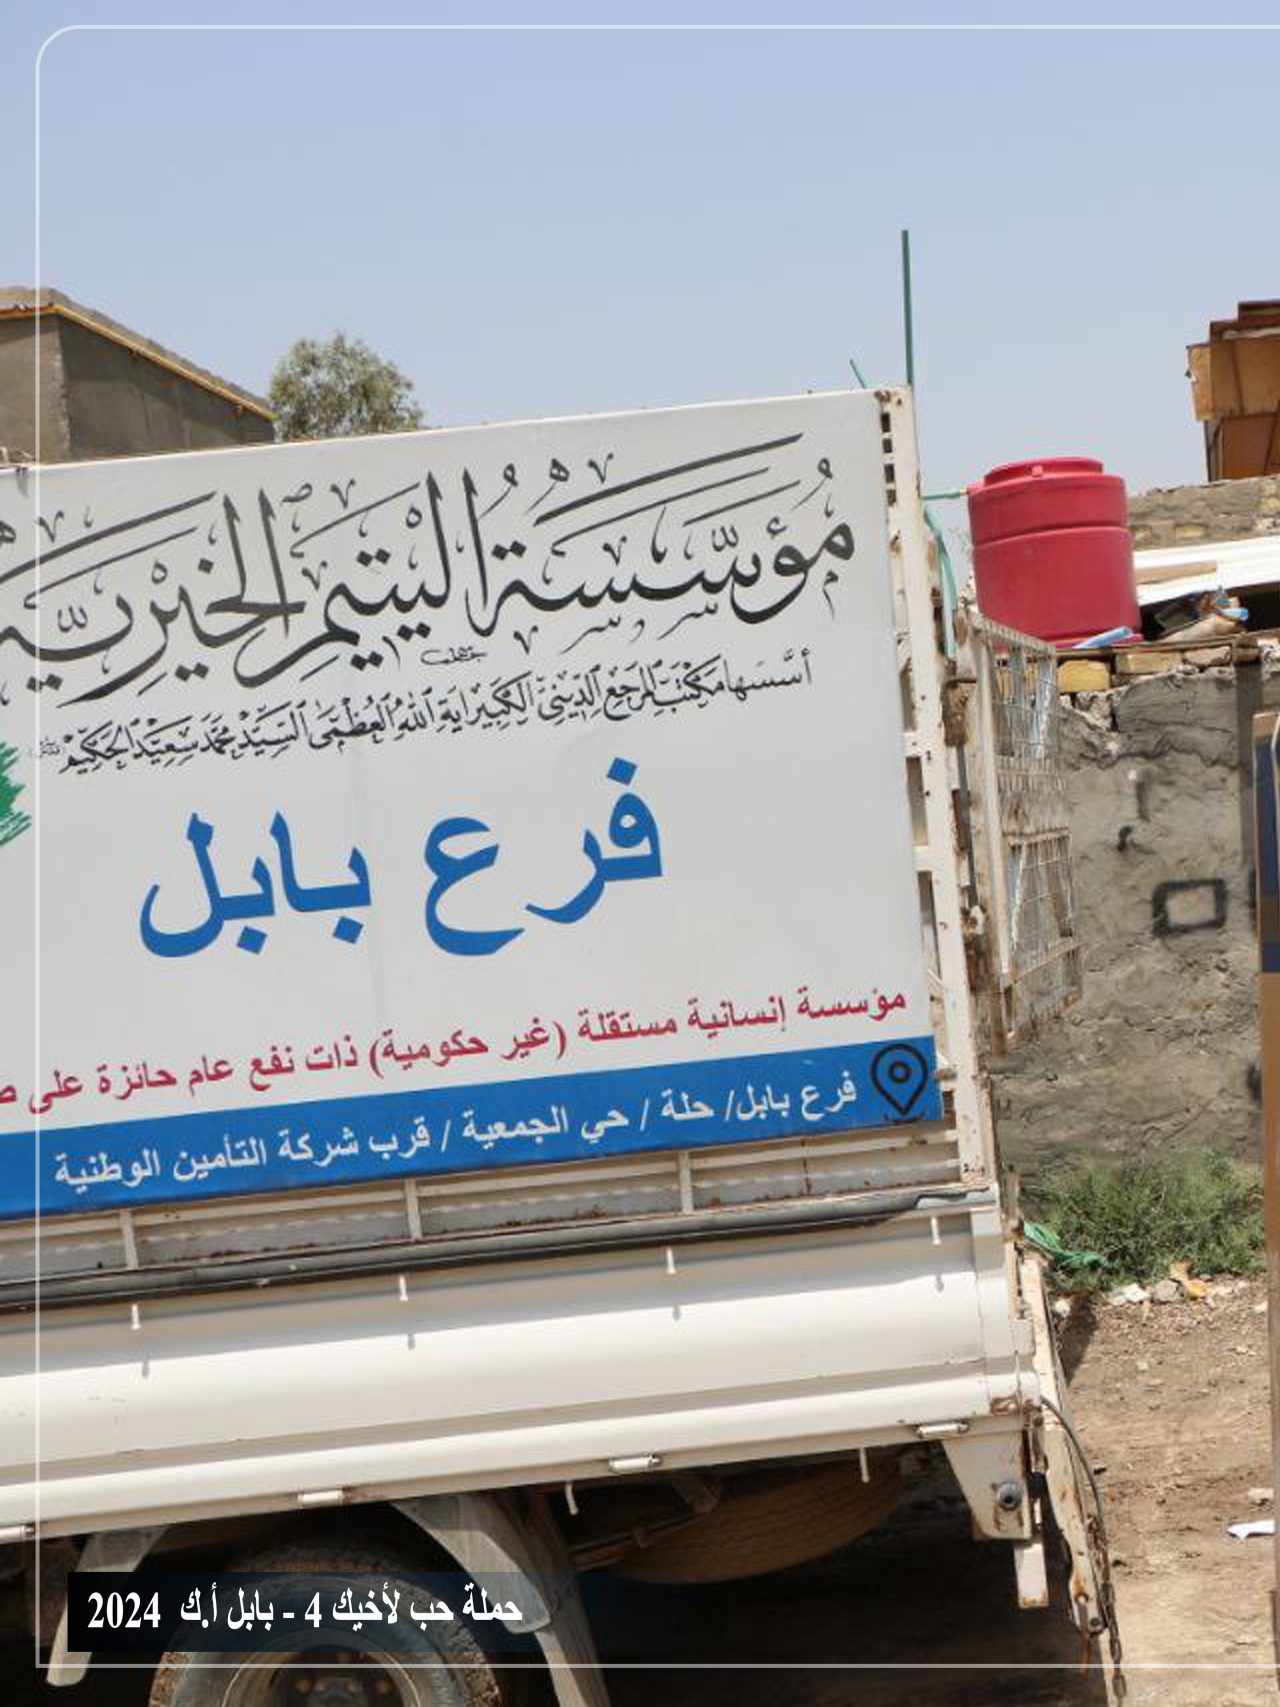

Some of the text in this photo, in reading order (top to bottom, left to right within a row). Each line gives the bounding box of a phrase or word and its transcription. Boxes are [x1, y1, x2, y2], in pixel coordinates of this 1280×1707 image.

[0, 490, 306, 709] الخيري
[140, 756, 663, 958] فرع بابل
[686, 996, 786, 1038] إنسانية
[796, 985, 906, 1024] مؤسسة
[577, 1008, 678, 1044] مستقلة
[249, 1044, 295, 1092] نفع
[305, 1034, 359, 1072] ذات
[28, 1070, 84, 1115] على
[97, 1061, 177, 1101] حائزة
[186, 1055, 234, 1098] عام
[800, 1071, 858, 1120] فرع
[581, 1105, 630, 1141] حي
[660, 1088, 715, 1122] حلة
[277, 1126, 359, 1168] شركة
[368, 1117, 431, 1159] قرب
[461, 1105, 568, 1151] الجمعية
[54, 1148, 161, 1195] الوطنية
[172, 1135, 267, 1183] التأمين
